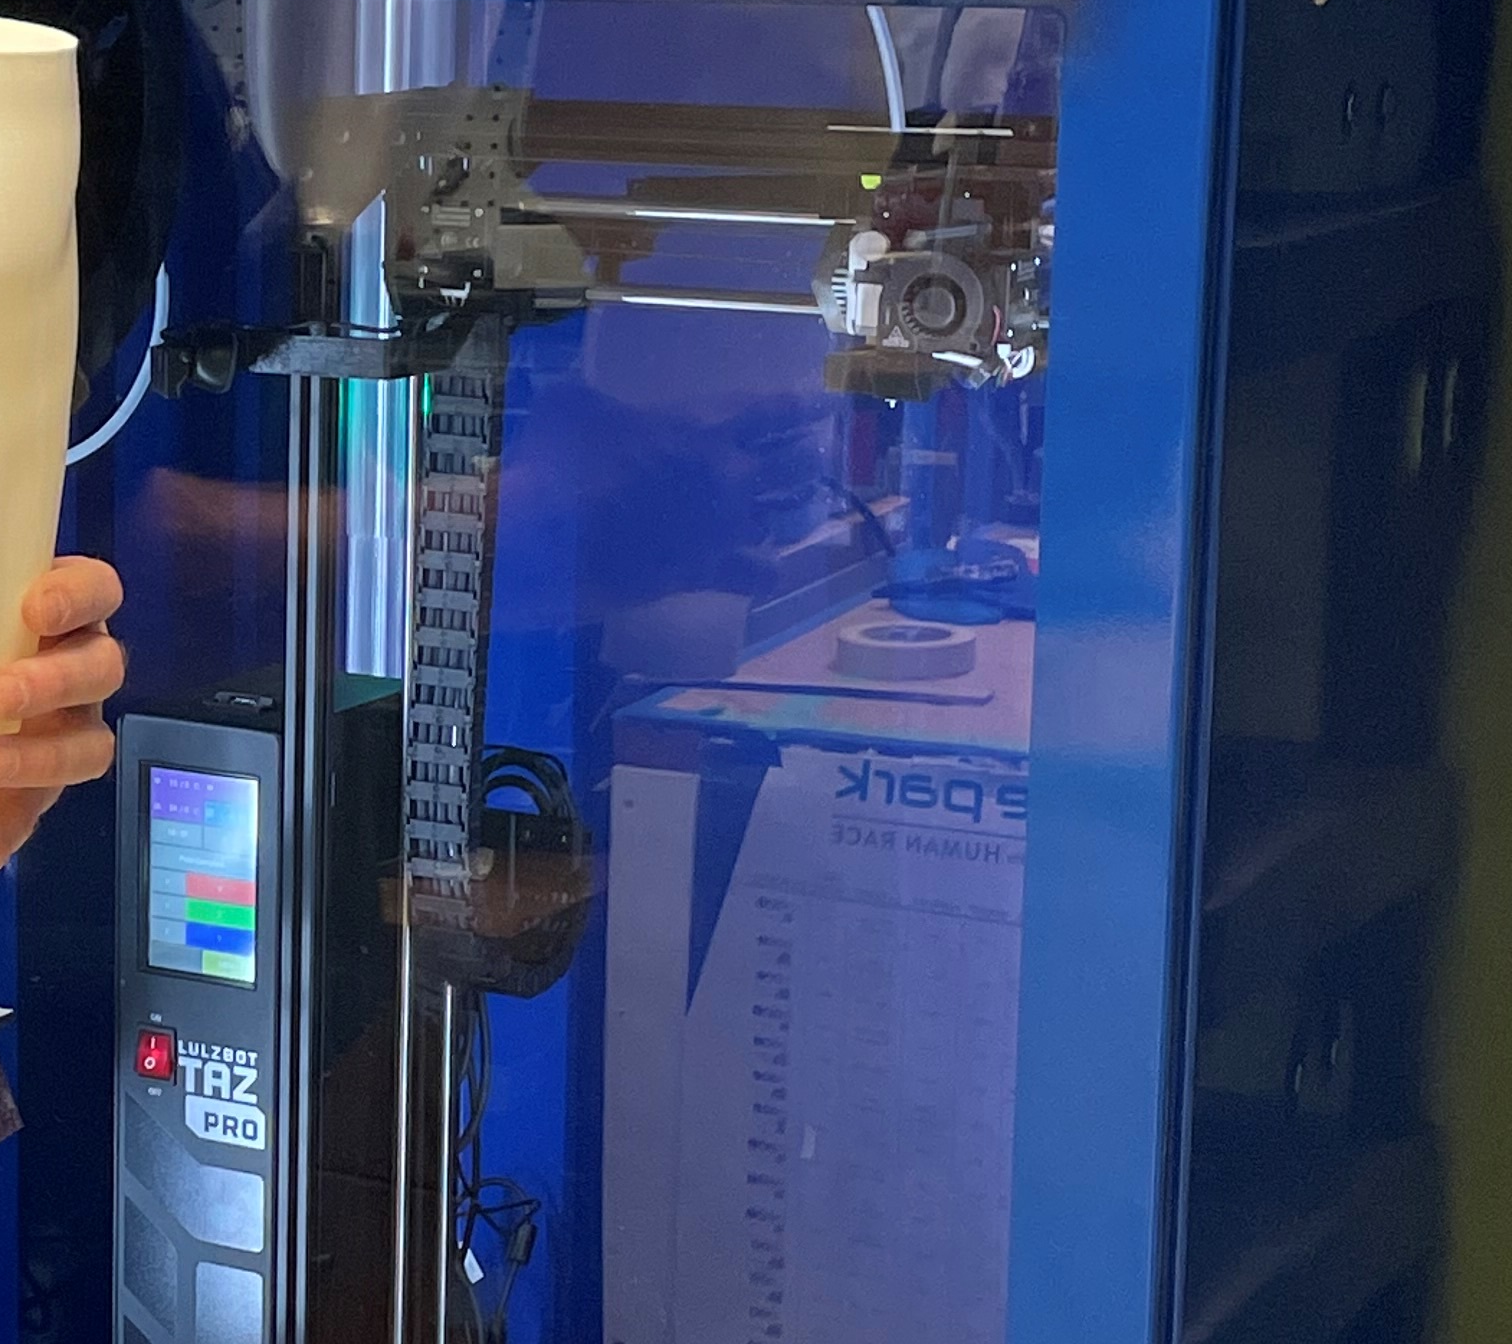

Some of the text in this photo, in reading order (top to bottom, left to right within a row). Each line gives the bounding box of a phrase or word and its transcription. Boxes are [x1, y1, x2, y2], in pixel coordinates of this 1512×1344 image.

[177, 1039, 259, 1067] LULZBOT
[178, 1055, 259, 1105] TAZ
[203, 1111, 259, 1142] PRO
